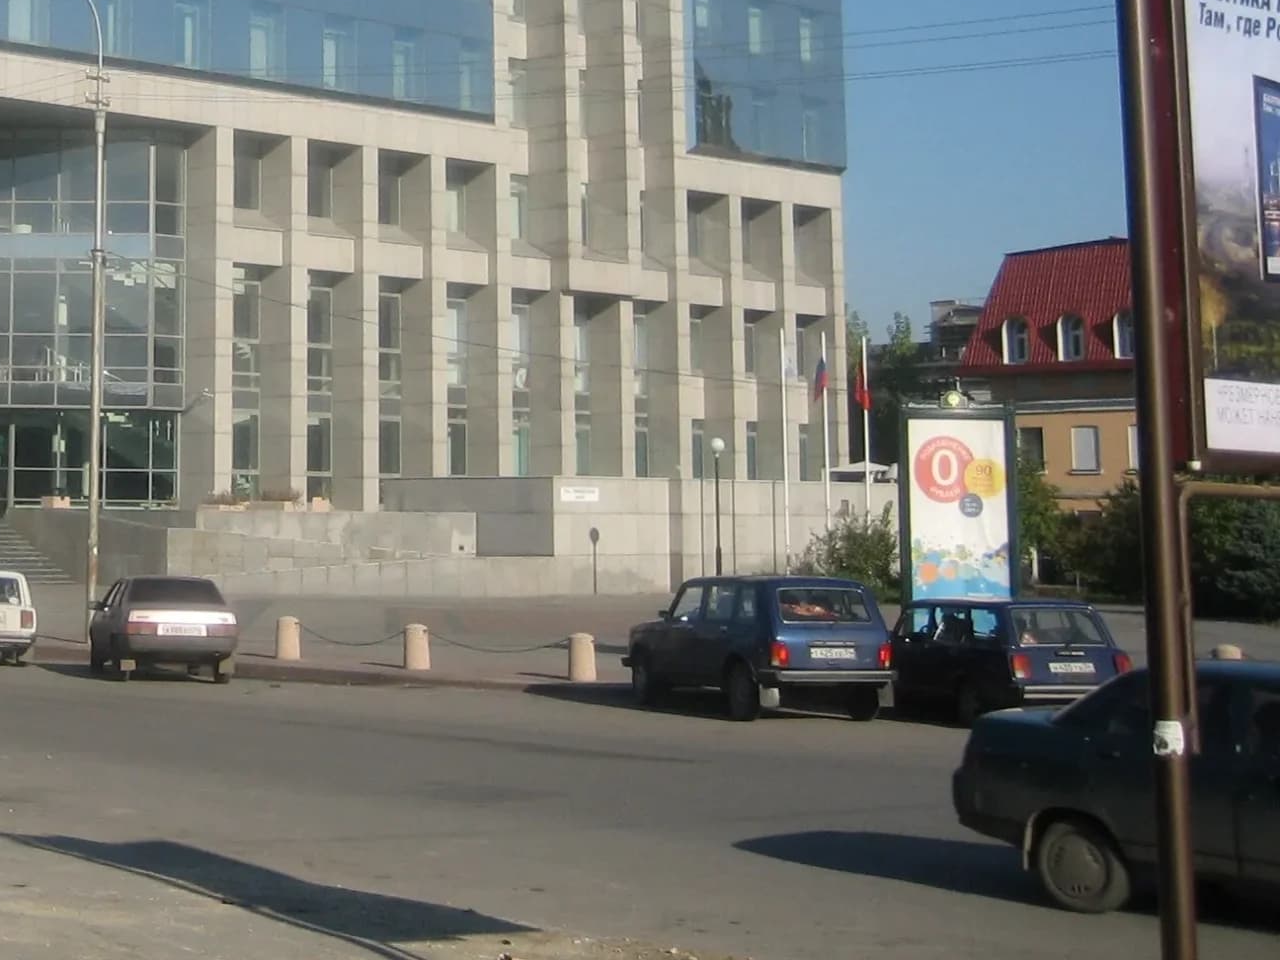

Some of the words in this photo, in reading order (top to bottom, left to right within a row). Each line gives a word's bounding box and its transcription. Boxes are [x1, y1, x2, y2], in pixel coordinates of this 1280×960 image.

[1199, 1, 1231, 33] Там,
[1236, 15, 1261, 38] где
[931, 449, 959, 487] 0
